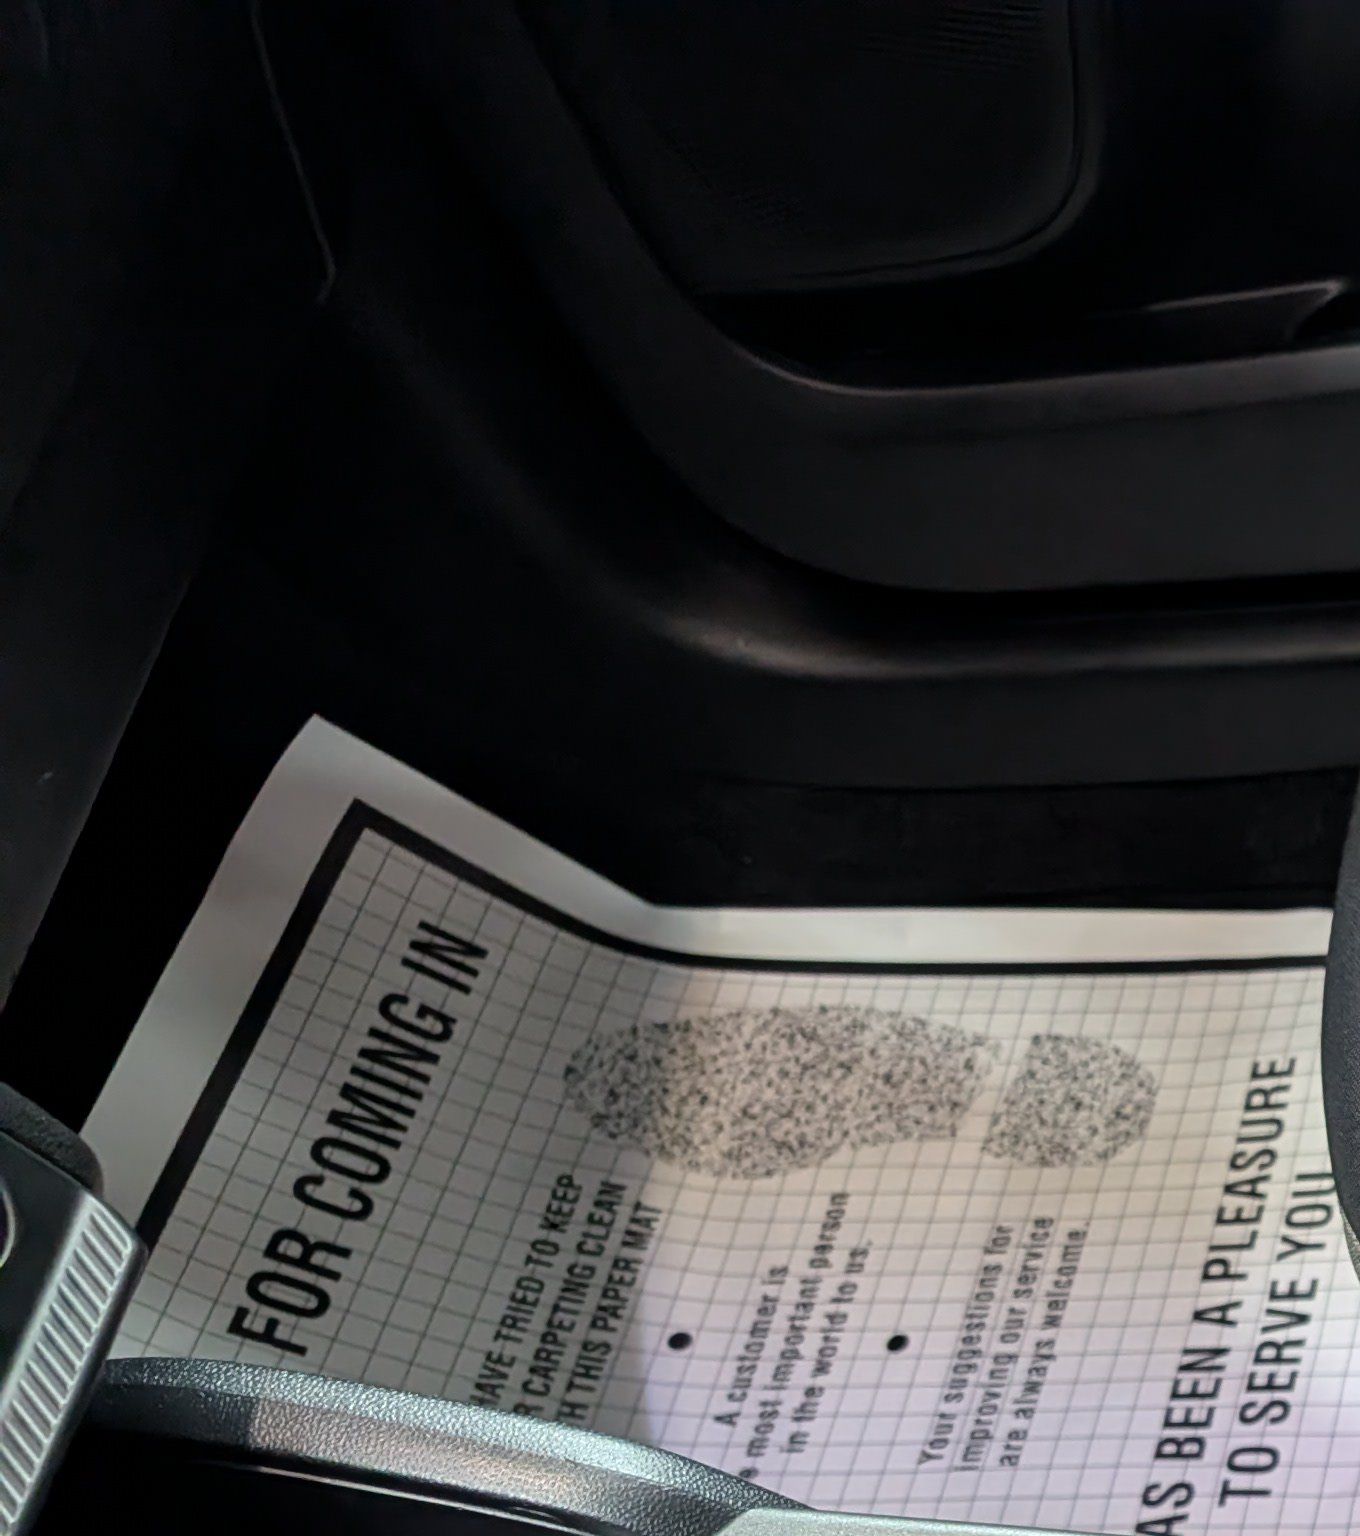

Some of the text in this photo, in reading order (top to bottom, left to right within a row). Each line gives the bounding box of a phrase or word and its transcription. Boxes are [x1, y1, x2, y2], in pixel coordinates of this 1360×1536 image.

[227, 920, 489, 1357] FOR COMING IN
[540, 1174, 583, 1233] KEEP
[1200, 1057, 1296, 1283] PLEASURE
[493, 1275, 545, 1343] TRIED
[521, 1263, 597, 1397] CARPETING
[576, 1180, 628, 1257] CLEAN
[525, 1238, 560, 1268] TO
[566, 1341, 612, 1393] THIS
[590, 1257, 644, 1333] PAPER
[621, 1200, 664, 1250] MAT
[809, 1192, 848, 1269] person
[1192, 1300, 1243, 1327] A
[713, 1265, 789, 1427] A customer is
[763, 1276, 822, 1390] important
[780, 1240, 872, 1453] in the world to us.
[917, 1225, 1013, 1465] Your suggestions for
[953, 1217, 1053, 1472] improving our service
[999, 1222, 1090, 1467] are always welcome.
[1153, 1347, 1232, 1460] BEEN
[1217, 1171, 1338, 1507] TO SERVE YOU
[746, 1399, 782, 1457] most
